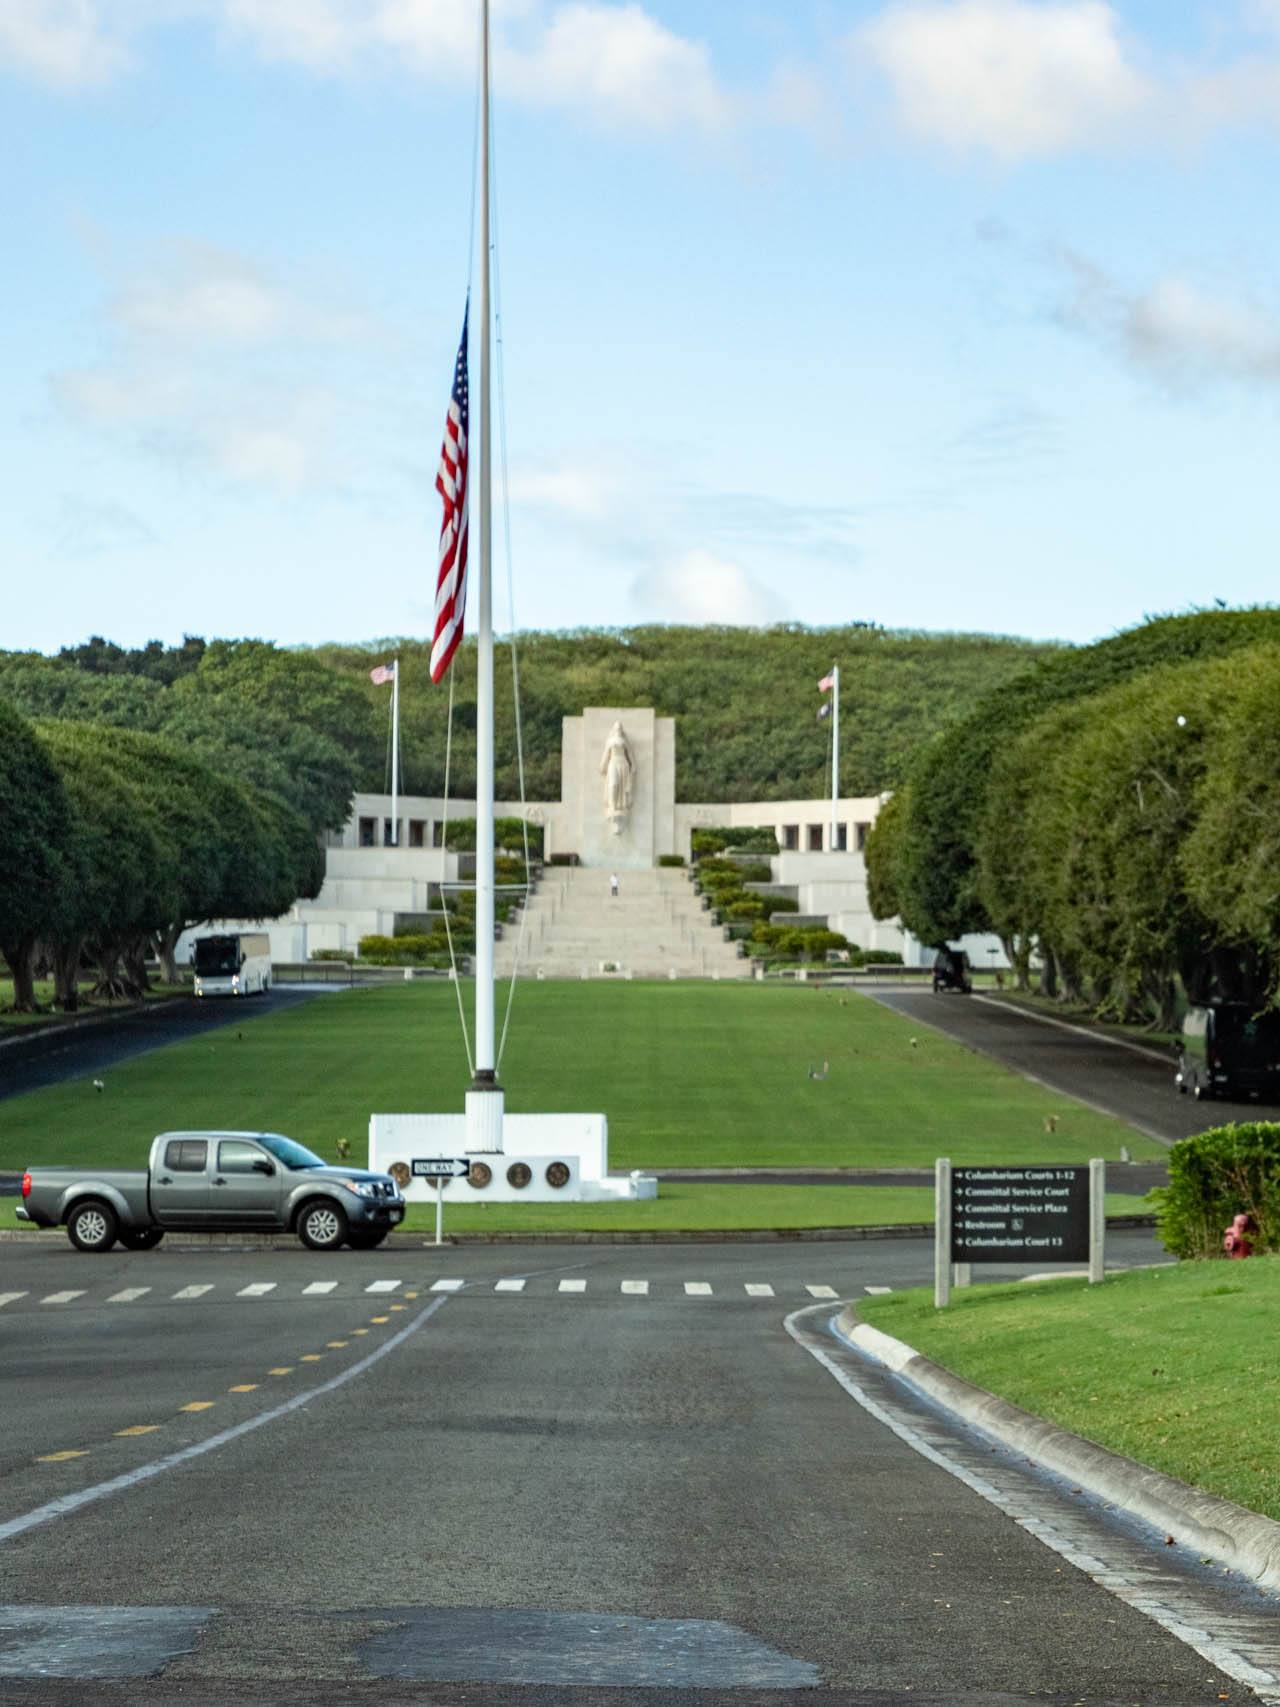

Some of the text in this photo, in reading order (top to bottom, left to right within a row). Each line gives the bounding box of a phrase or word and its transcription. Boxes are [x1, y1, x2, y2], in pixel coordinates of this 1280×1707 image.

[416, 1163, 452, 1173] ONE WAY
[965, 1171, 1075, 1180] Columbarium Courts 1-12
[965, 1187, 1070, 1197] Committal Service Court
[965, 1204, 1068, 1213] Committal Service Plaza
[965, 1220, 1006, 1230] Restroom
[965, 1237, 1024, 1247] Columbarium
[1025, 1236, 1050, 1247] Court
